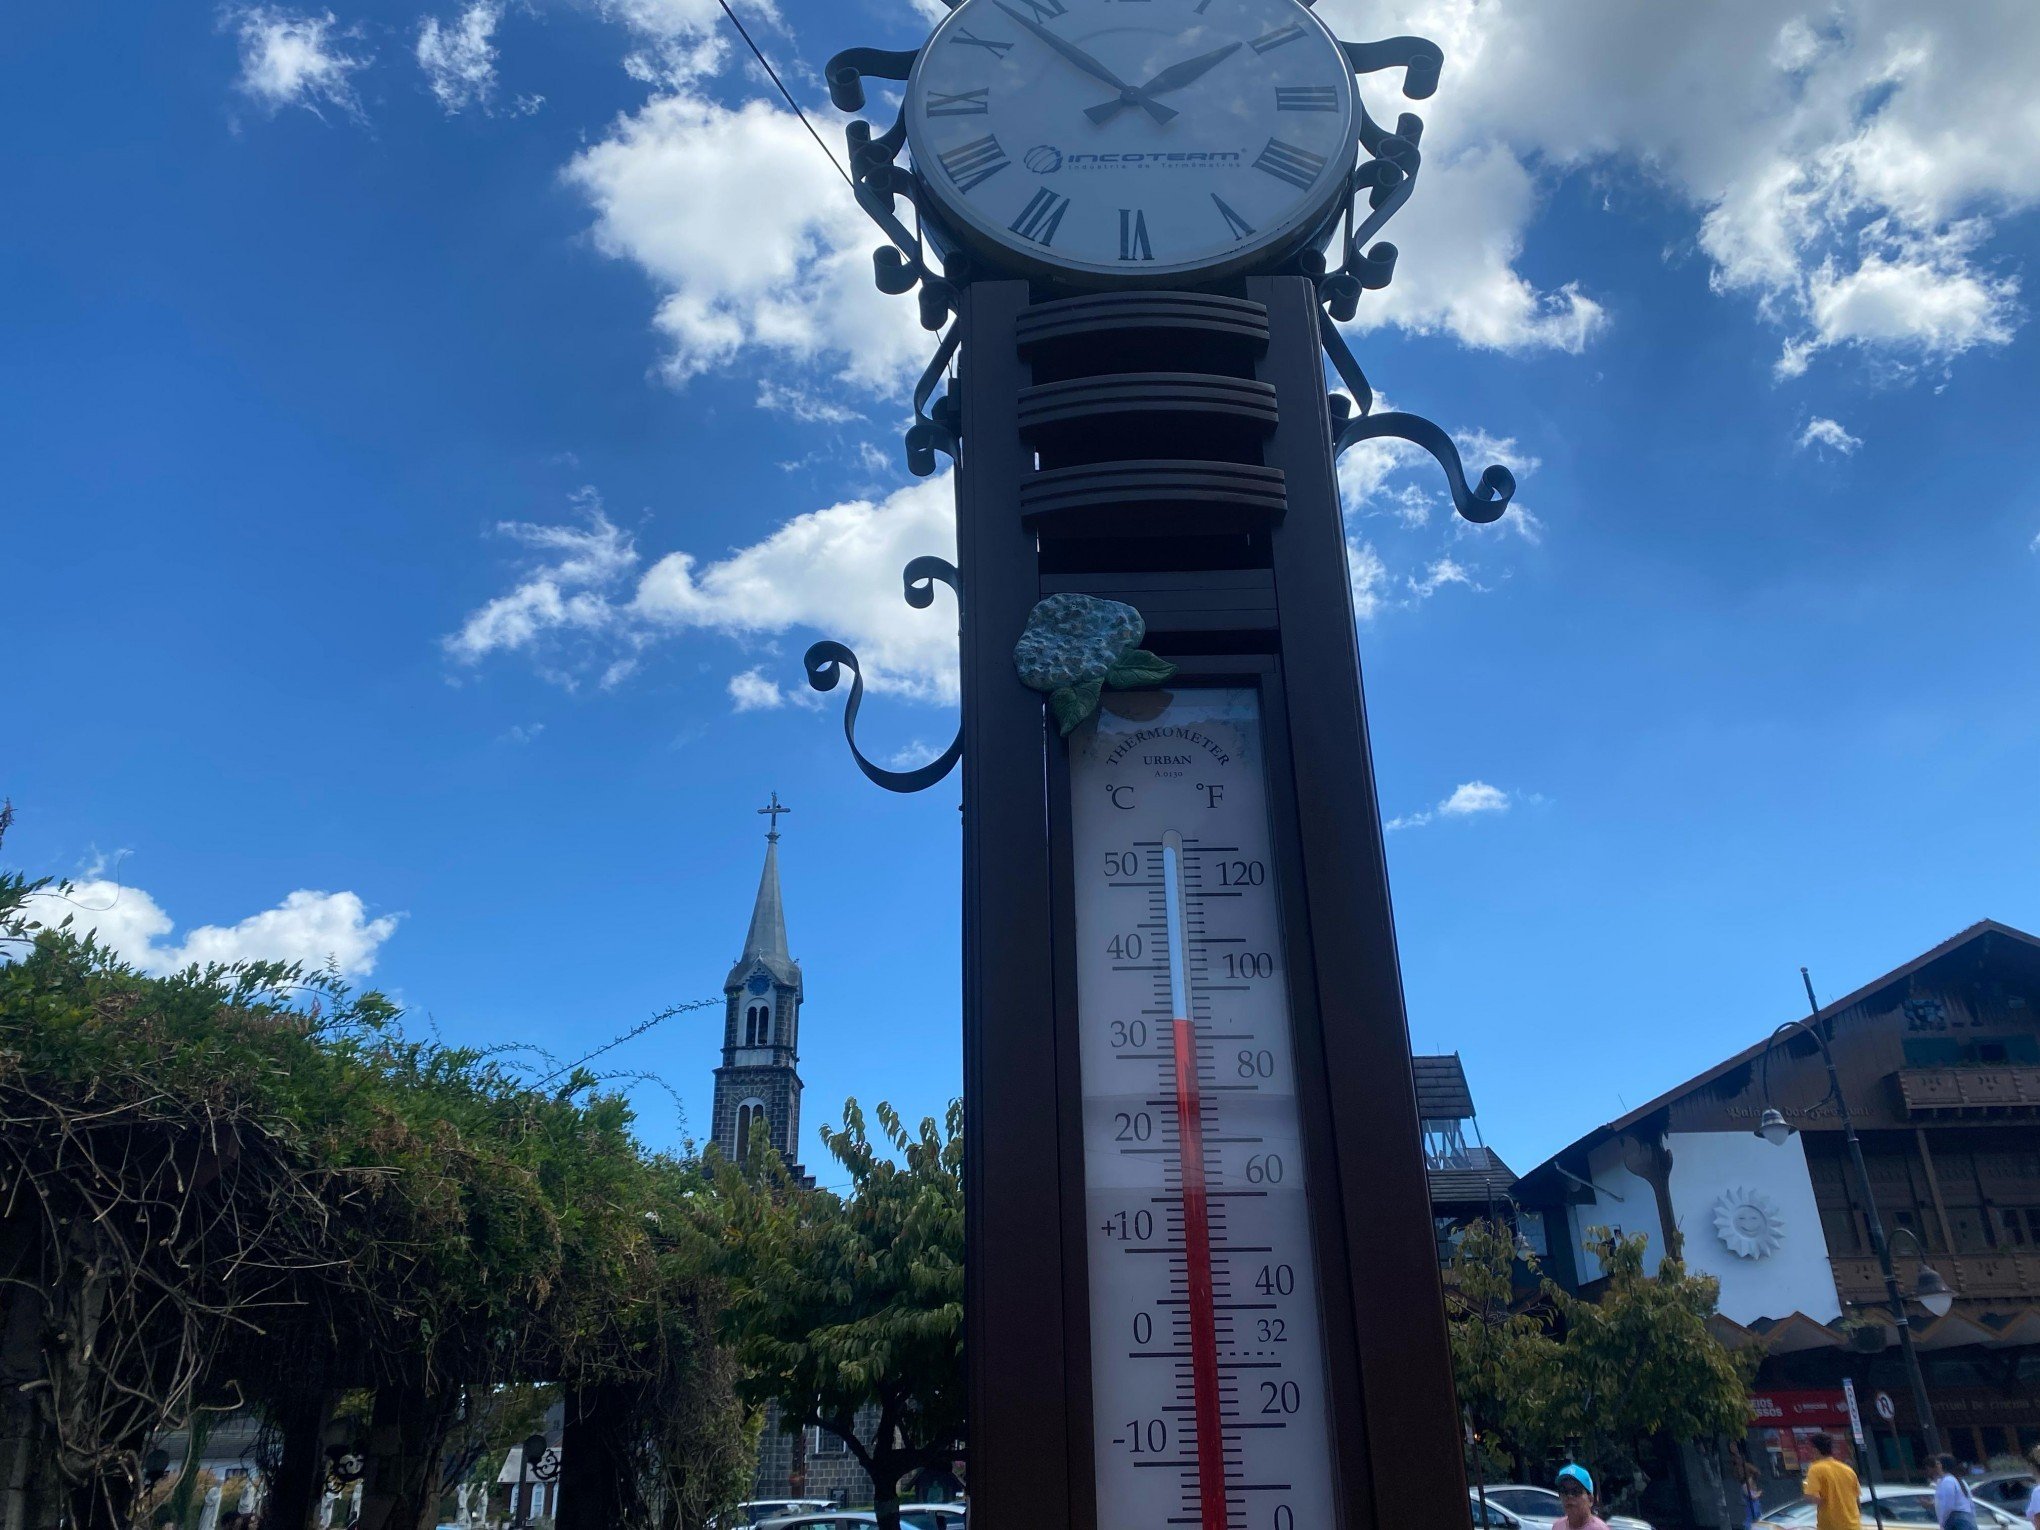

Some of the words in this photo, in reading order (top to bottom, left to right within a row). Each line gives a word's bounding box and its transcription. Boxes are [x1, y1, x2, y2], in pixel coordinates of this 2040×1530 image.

[949, 27, 1014, 60] X
[1247, 22, 1309, 55] II
[926, 87, 990, 118] IX
[1275, 85, 1339, 113] III
[1068, 152, 1240, 163] INCOTERM
[1007, 186, 1071, 247] VII
[1211, 192, 1257, 241] V
[1117, 209, 1156, 261] VI
[1106, 726, 1230, 767] THERMOMETER
[1143, 754, 1193, 765] URBAN
[1103, 851, 1139, 876] 50
[1216, 860, 1265, 886] 120
[1106, 933, 1143, 960] 40
[1222, 952, 1273, 979] 100
[1110, 1020, 1147, 1048] 30
[1237, 1050, 1274, 1078] 80
[1114, 1112, 1152, 1142] 20
[1245, 1154, 1283, 1184] 60
[1101, 1209, 1153, 1241] +10
[1255, 1264, 1295, 1296] 40
[1133, 1312, 1152, 1344] 0
[1256, 1318, 1288, 1343] 32
[1260, 1381, 1300, 1414] 20
[1112, 1419, 1167, 1453] -10
[1273, 1504, 1294, 1530] 0
